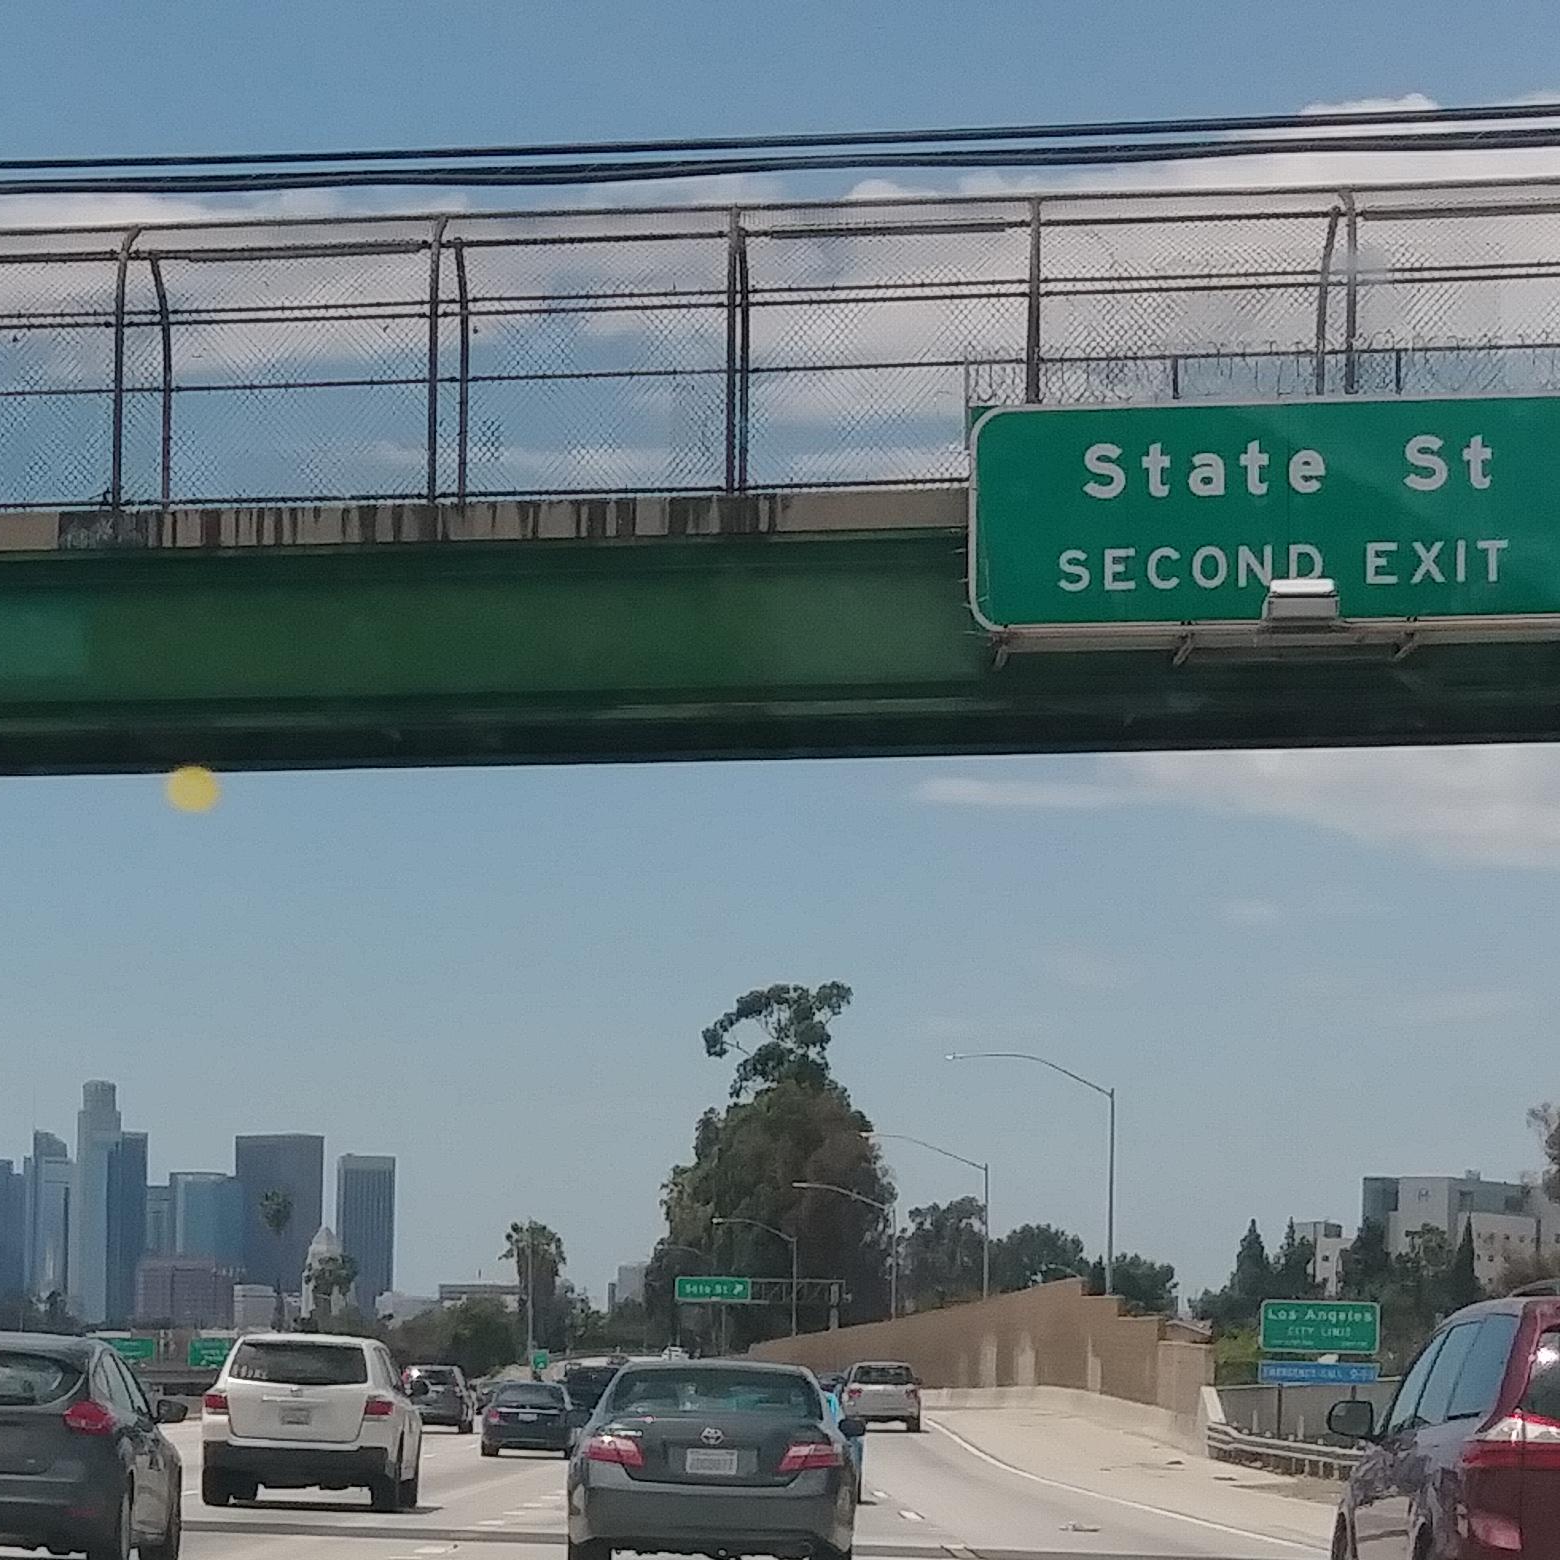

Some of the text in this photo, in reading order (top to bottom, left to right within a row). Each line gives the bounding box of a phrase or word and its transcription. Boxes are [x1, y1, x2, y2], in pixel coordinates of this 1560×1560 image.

[1083, 434, 1493, 499] State St
[1058, 539, 1509, 592] SECOND EXIT
[1267, 1308, 1373, 1324] Los Angeles
[1287, 1326, 1315, 1337] CITY
